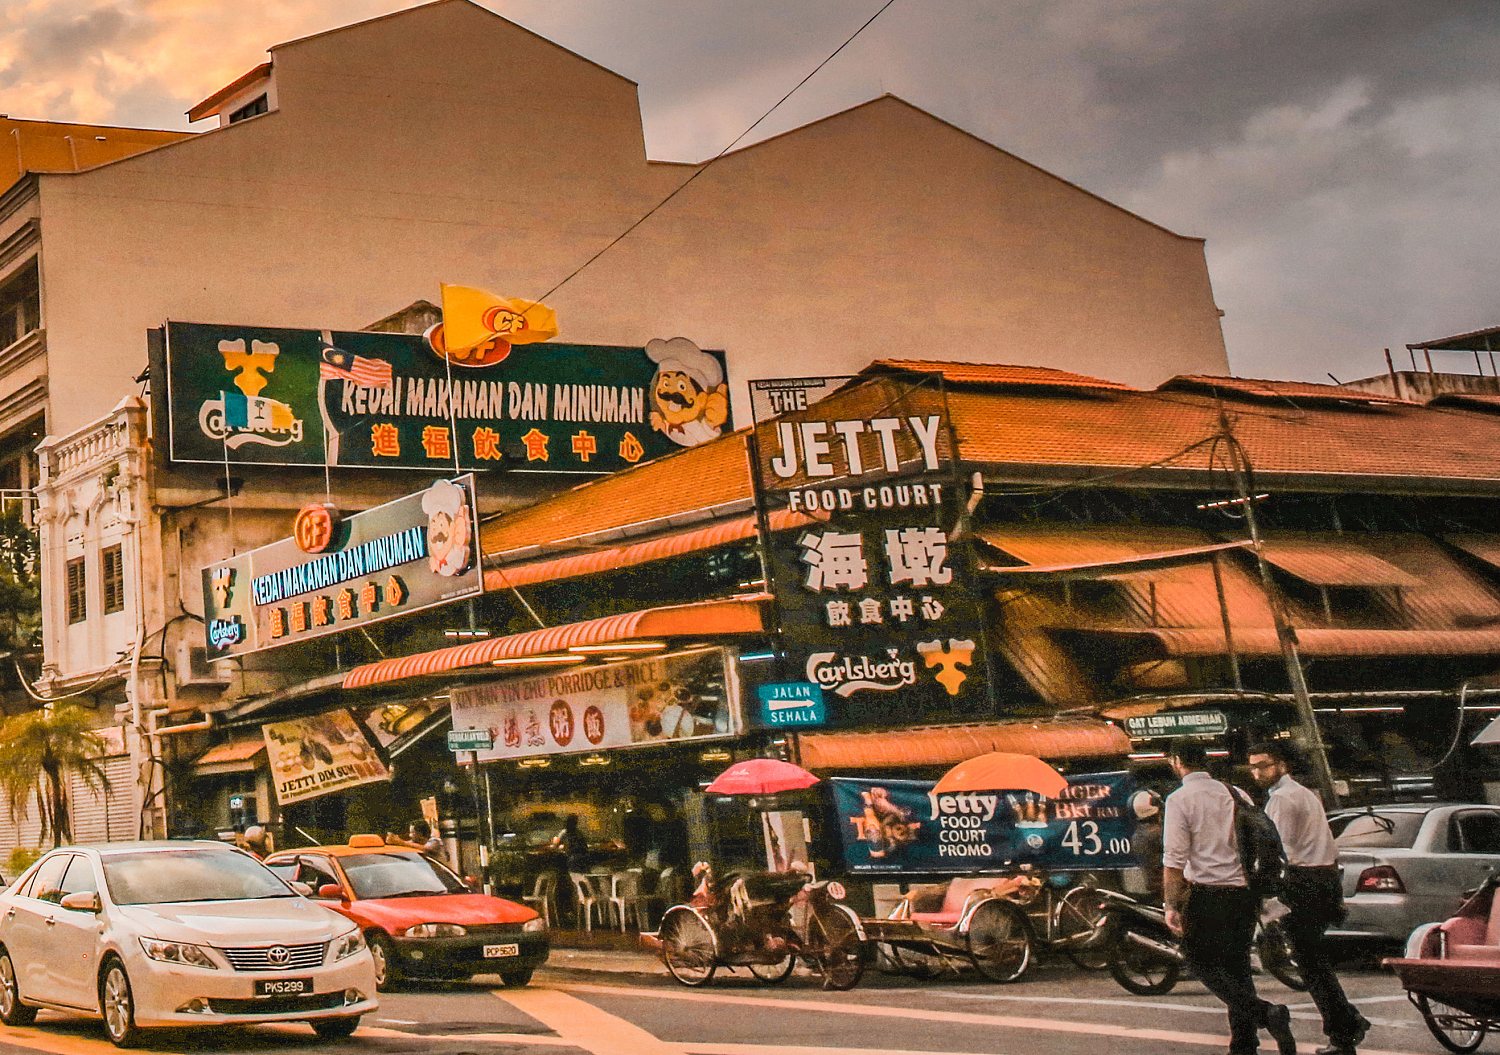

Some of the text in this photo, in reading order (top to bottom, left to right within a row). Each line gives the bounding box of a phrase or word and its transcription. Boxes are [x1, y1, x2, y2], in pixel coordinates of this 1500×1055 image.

[341, 376, 644, 424] KEDAI MAKANAN DAN MINUMAN
[769, 390, 807, 412] THE
[371, 422, 644, 463] 進福飲食中心
[772, 415, 941, 478] JETTY
[788, 484, 942, 511] FOOD COURT
[251, 525, 425, 606] KEDAI MAKANAN DAN MINUMAN
[269, 575, 402, 638] 進福飲食中心
[826, 596, 945, 626] 飲食中心
[548, 669, 611, 695] PORRIDGE
[806, 650, 916, 696] Carlsberg
[773, 686, 811, 698] JALAN
[771, 710, 817, 723] SEHALA
[1128, 713, 1222, 728] GAT LEBUH ARMENIAN
[280, 773, 316, 793] JETTY
[318, 768, 337, 782] DIM
[1060, 785, 1111, 799] IGER
[927, 791, 997, 821] Jetty
[940, 816, 981, 828] FOOD
[939, 829, 986, 842] COURT
[1061, 820, 1131, 855] 43.00
[938, 844, 992, 857] PROMO
